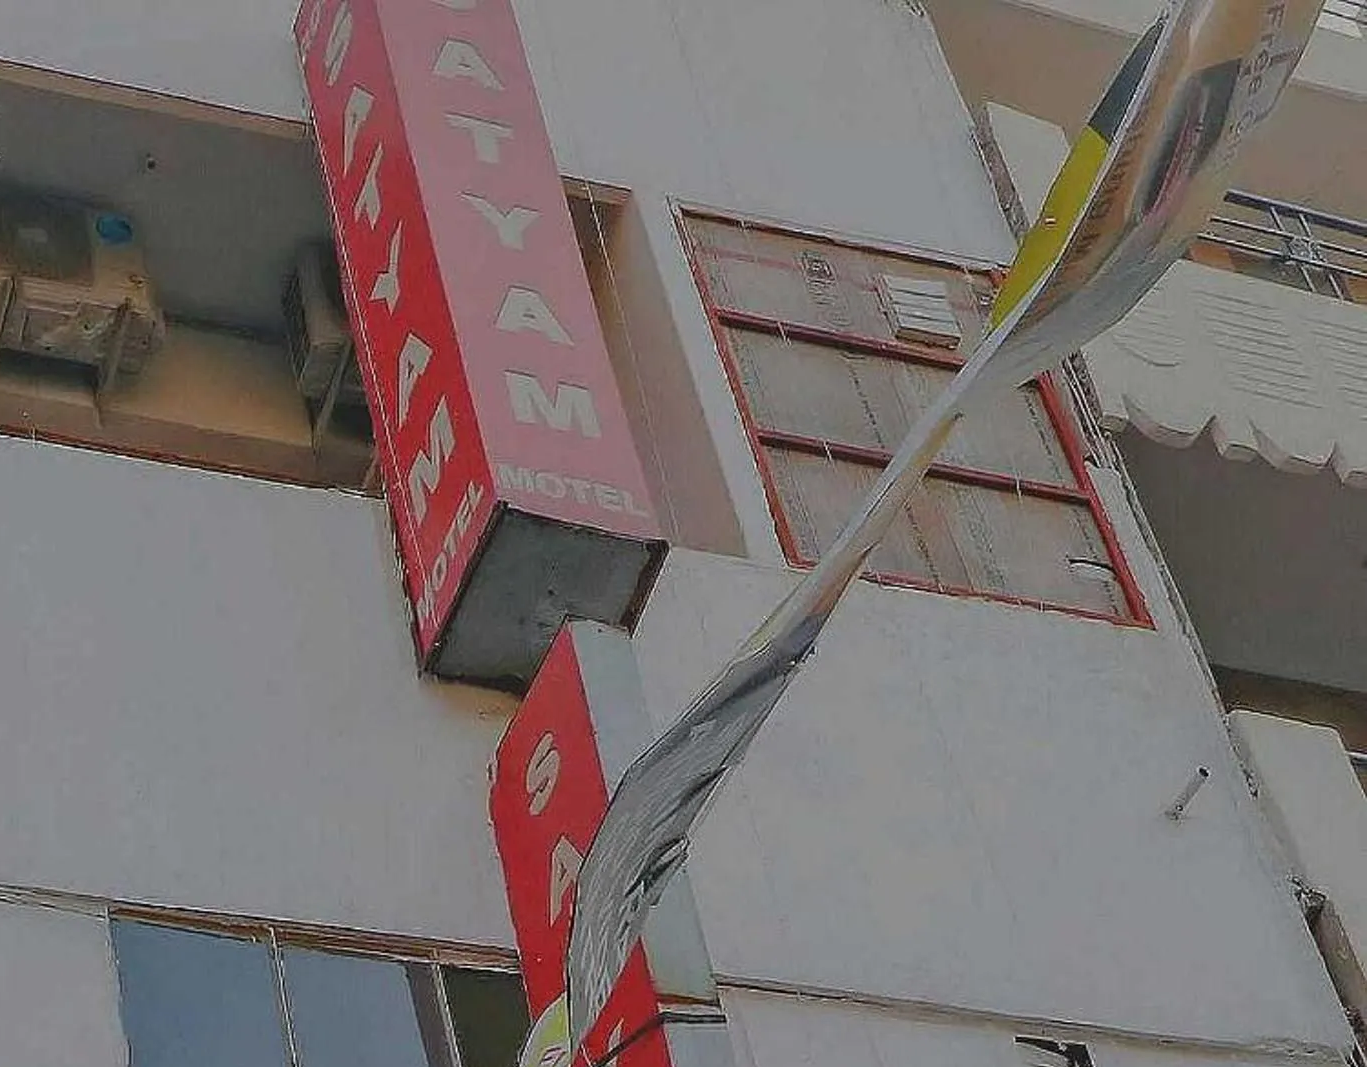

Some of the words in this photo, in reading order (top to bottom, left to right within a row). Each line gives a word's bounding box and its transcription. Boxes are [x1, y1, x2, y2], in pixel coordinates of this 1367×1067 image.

[432, 0, 601, 440] ATYAM
[416, 480, 483, 630] MOTEL
[495, 464, 651, 519] MOTEL
